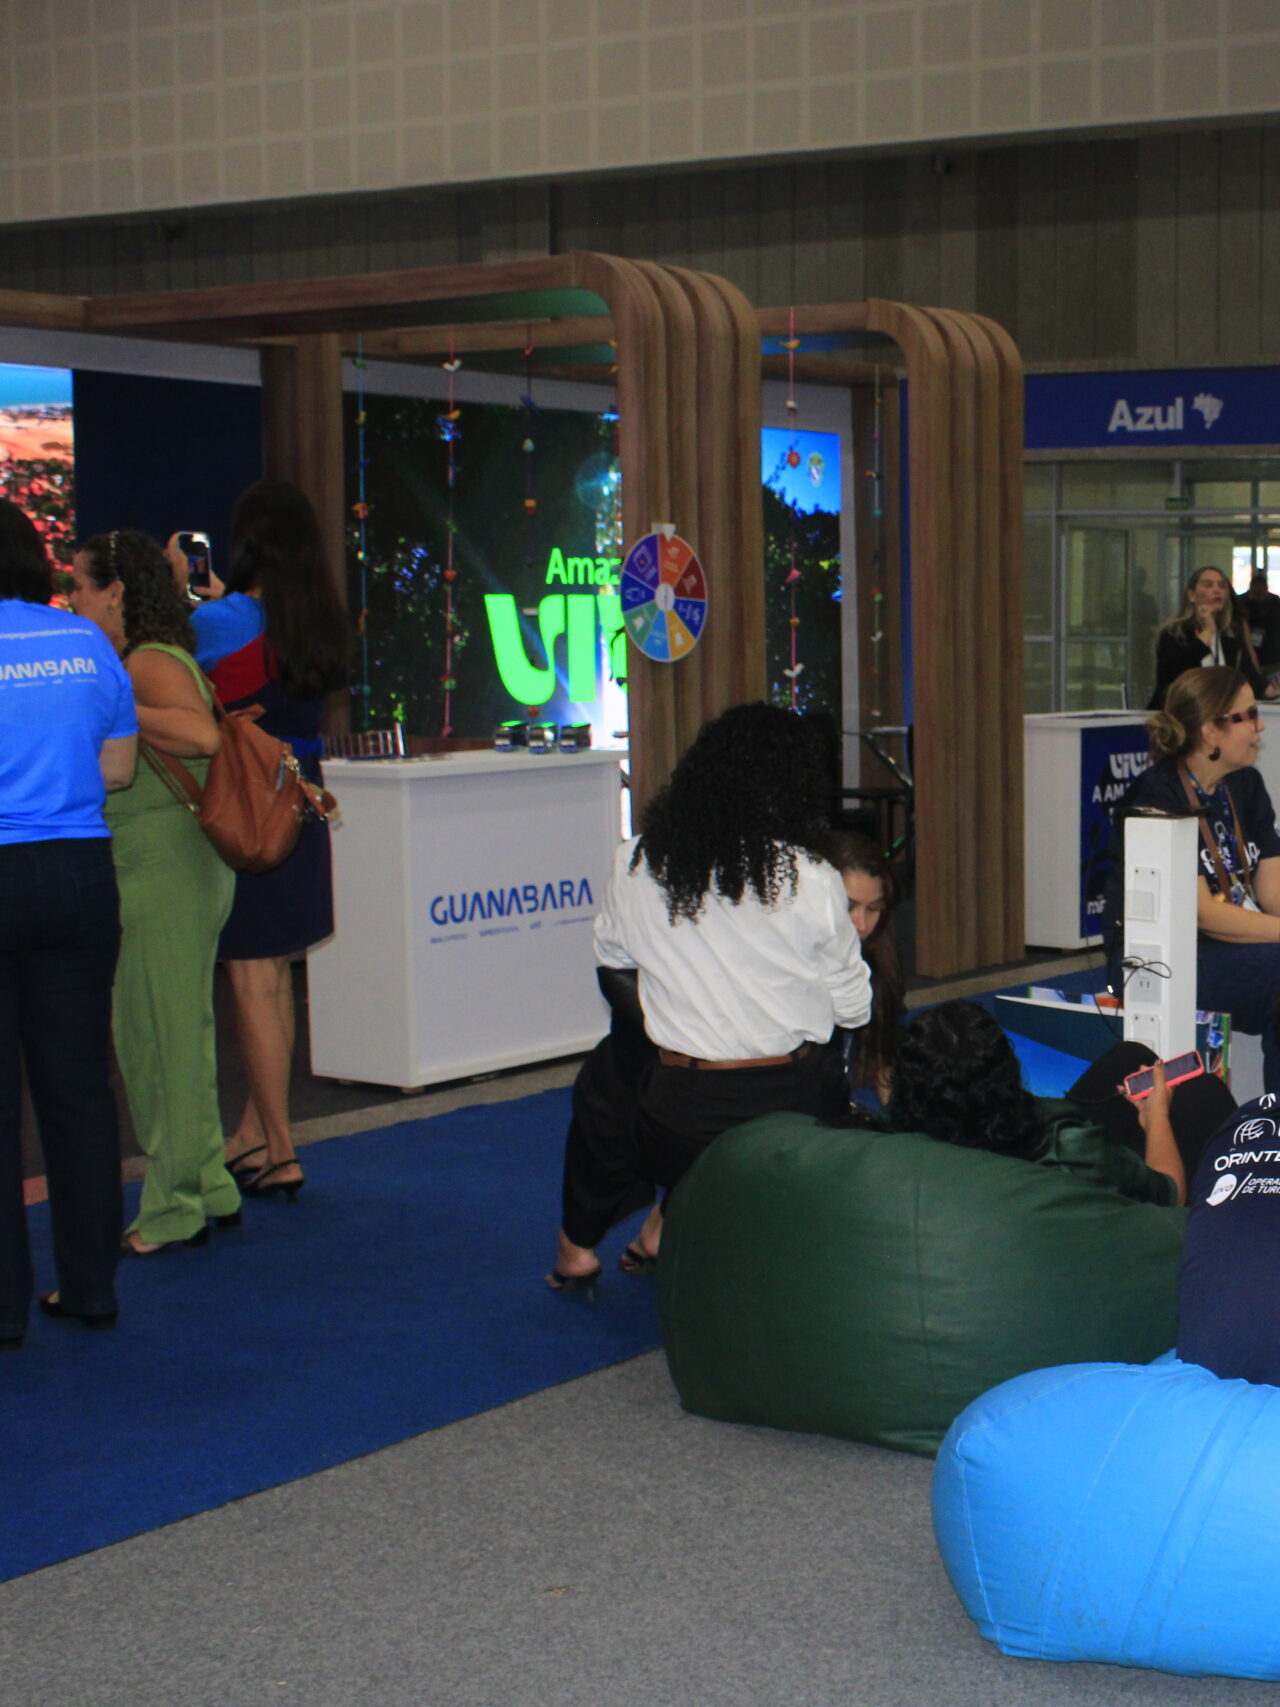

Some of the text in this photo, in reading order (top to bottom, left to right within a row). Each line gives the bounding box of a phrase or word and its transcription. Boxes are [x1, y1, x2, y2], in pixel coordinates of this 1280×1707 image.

[1107, 396, 1184, 433] Azul
[0, 657, 97, 681] ANABARA
[430, 877, 594, 926] GUANABARA
[1241, 1185, 1255, 1194] DE
